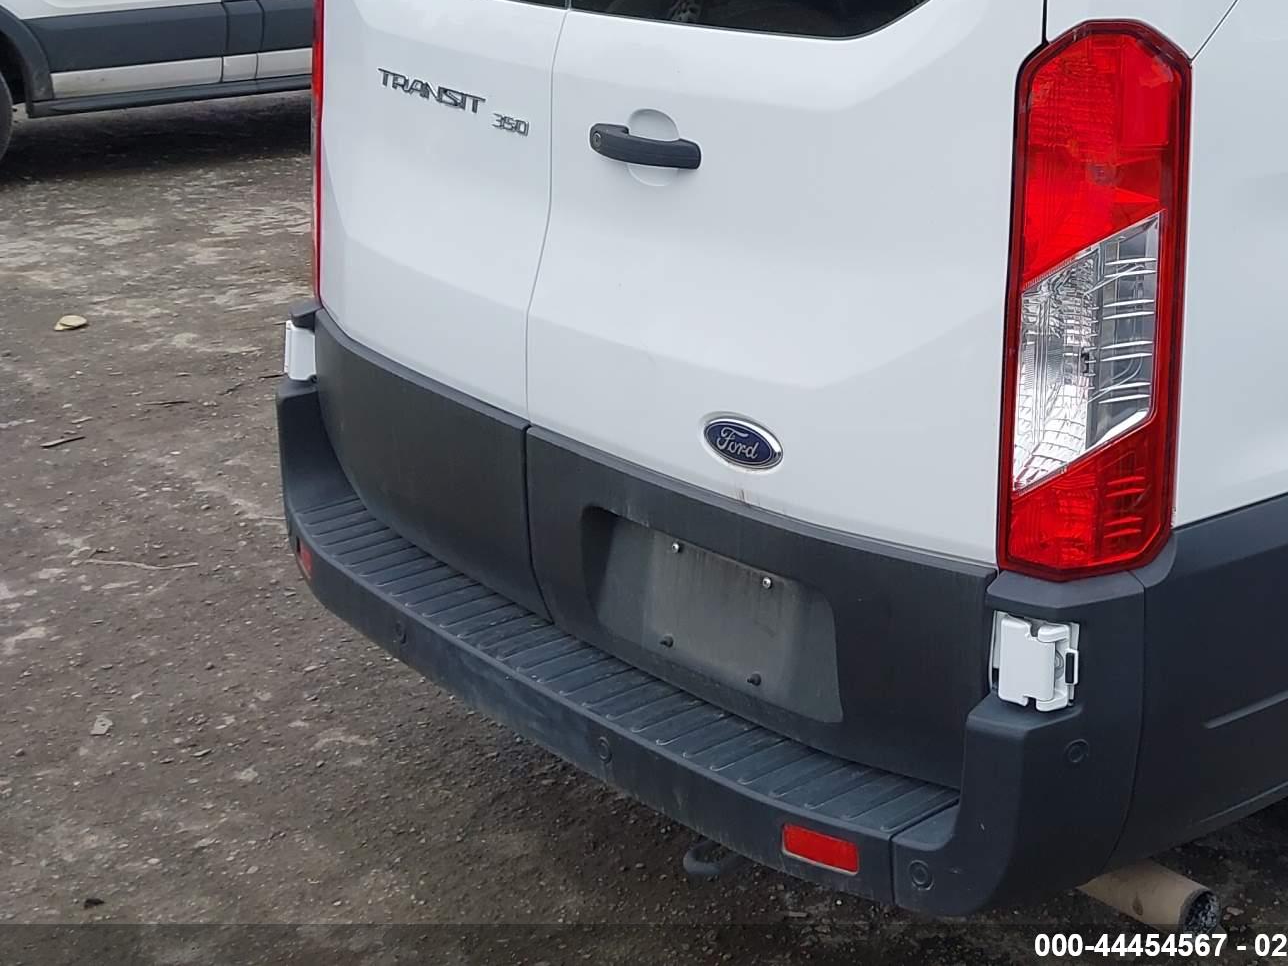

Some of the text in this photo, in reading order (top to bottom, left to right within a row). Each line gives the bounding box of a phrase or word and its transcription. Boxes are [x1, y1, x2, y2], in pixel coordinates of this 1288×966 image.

[377, 67, 530, 137] TRANSIT 350
[716, 426, 760, 460] Ford
